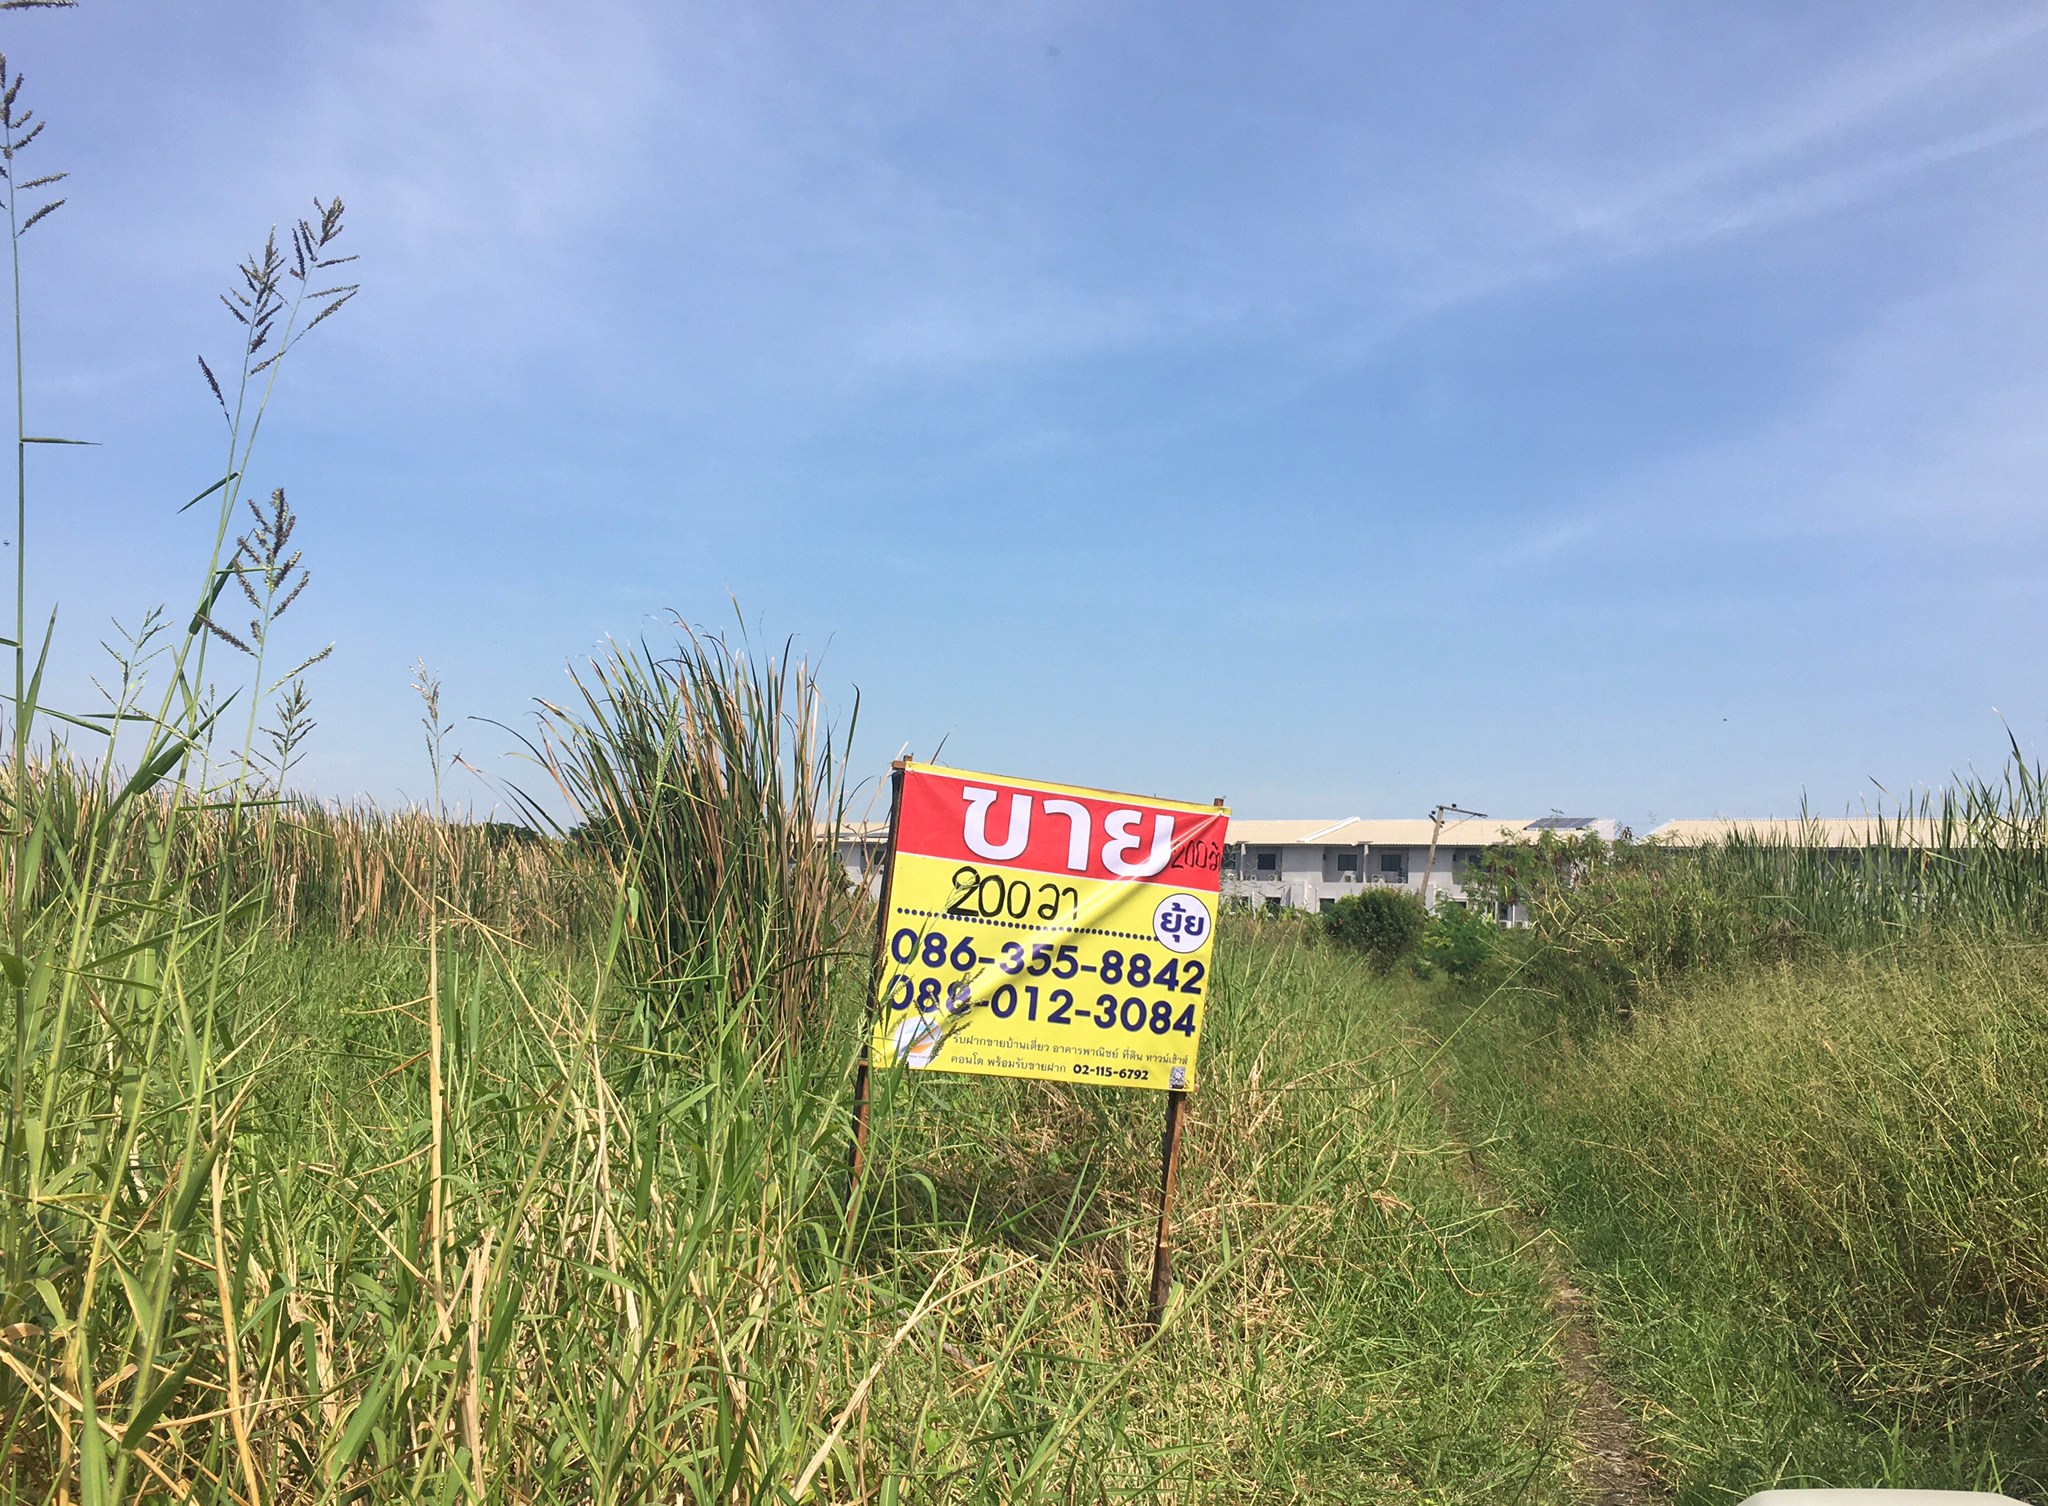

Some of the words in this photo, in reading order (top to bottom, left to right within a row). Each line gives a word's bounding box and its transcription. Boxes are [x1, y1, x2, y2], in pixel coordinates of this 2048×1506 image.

[962, 785, 1175, 877] ขาย
[1160, 901, 1204, 944] ยุ้ย
[891, 927, 1206, 995] 086-355-8842
[951, 1053, 984, 1066] คอนโด
[1073, 1064, 1149, 1080] 02-115-6792
